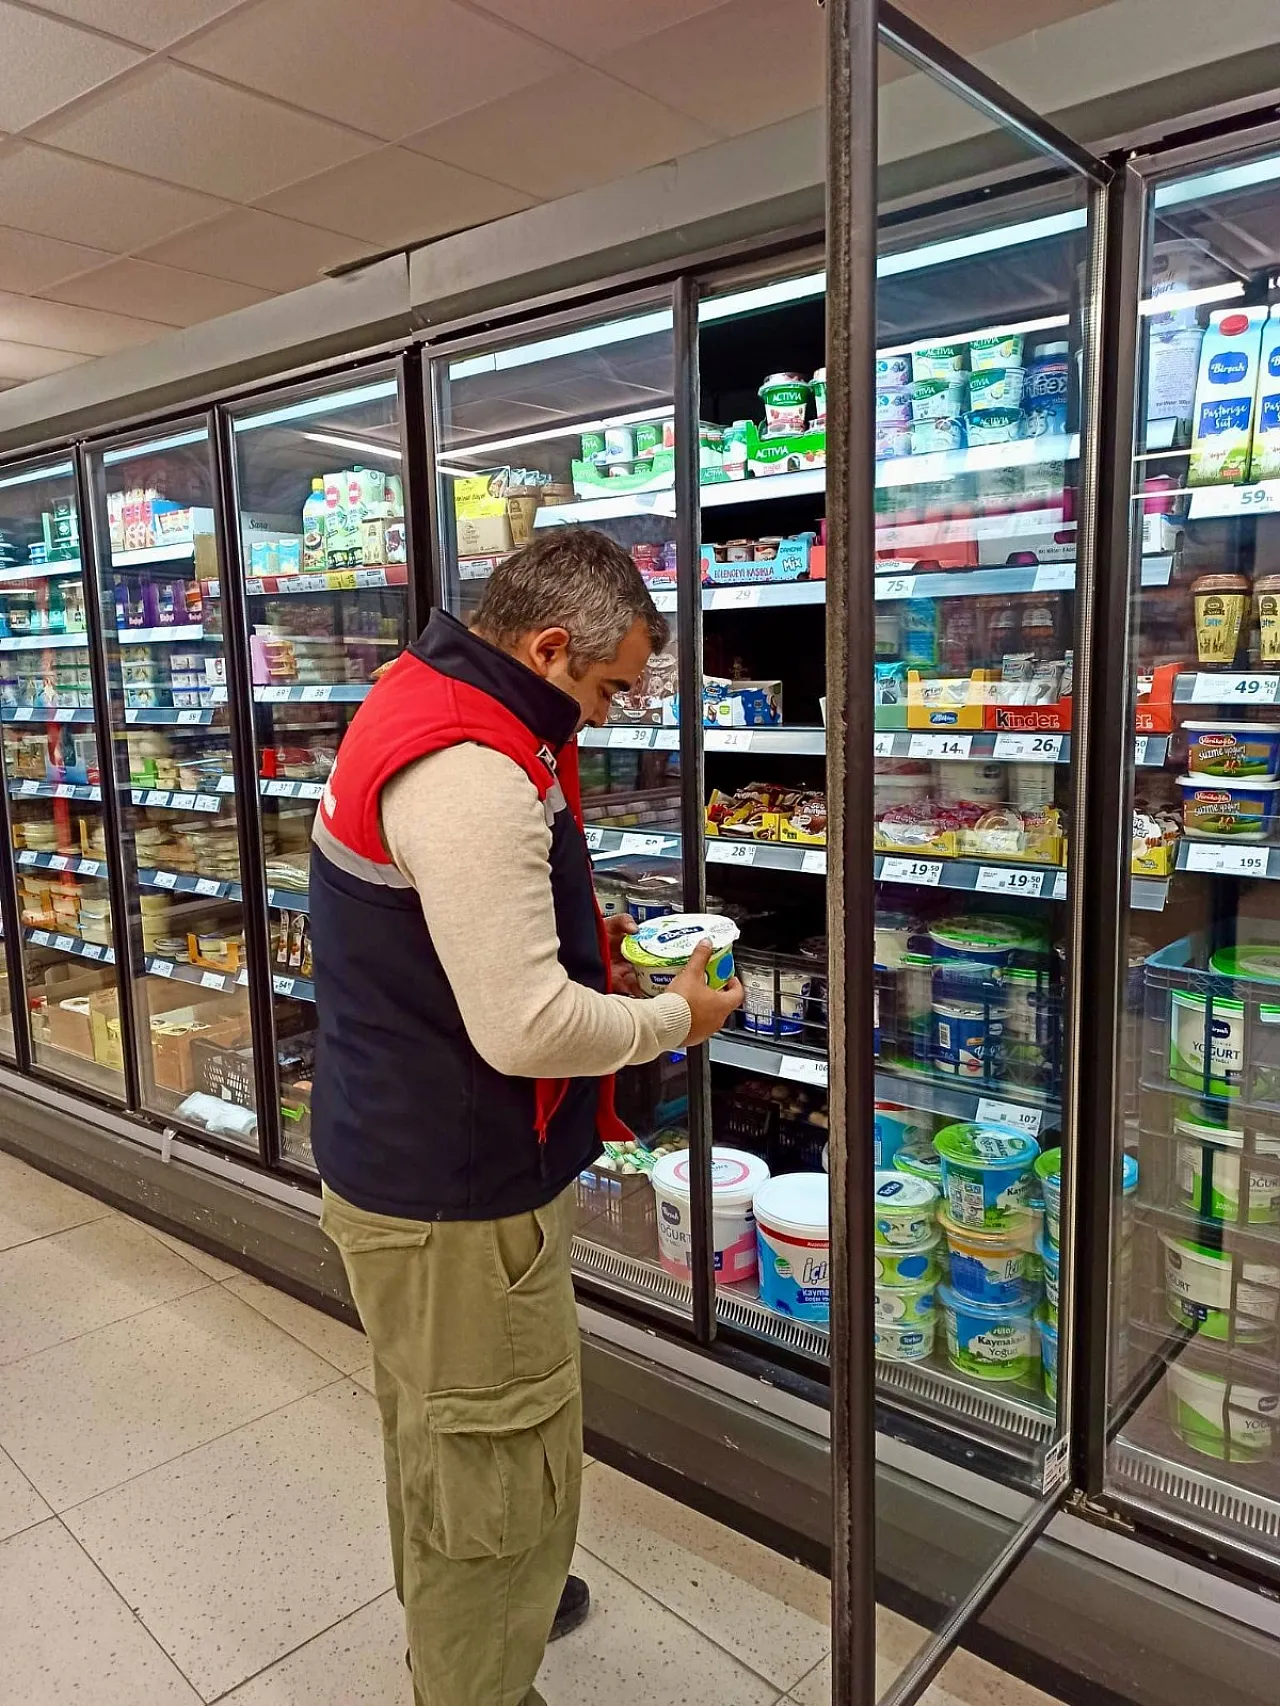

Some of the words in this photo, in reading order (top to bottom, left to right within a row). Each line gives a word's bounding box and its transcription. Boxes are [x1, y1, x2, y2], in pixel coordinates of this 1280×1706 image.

[772, 391, 802, 401] ACTIVIA
[756, 446, 790, 459] ACTIVIA
[1241, 489, 1266, 505] 59
[783, 556, 802, 573] Mix
[887, 580, 905, 592] 75
[735, 590, 752, 601] 29
[632, 729, 647, 741] 39
[874, 742, 882, 754] 4
[941, 741, 958, 754] 14
[1032, 738, 1053, 752] 26
[731, 846, 746, 857] 28
[1240, 858, 1262, 868] 195
[1018, 1114, 1037, 1124] 107
[659, 1222, 691, 1243] OĞURT
[802, 1289, 829, 1297] Kayma
